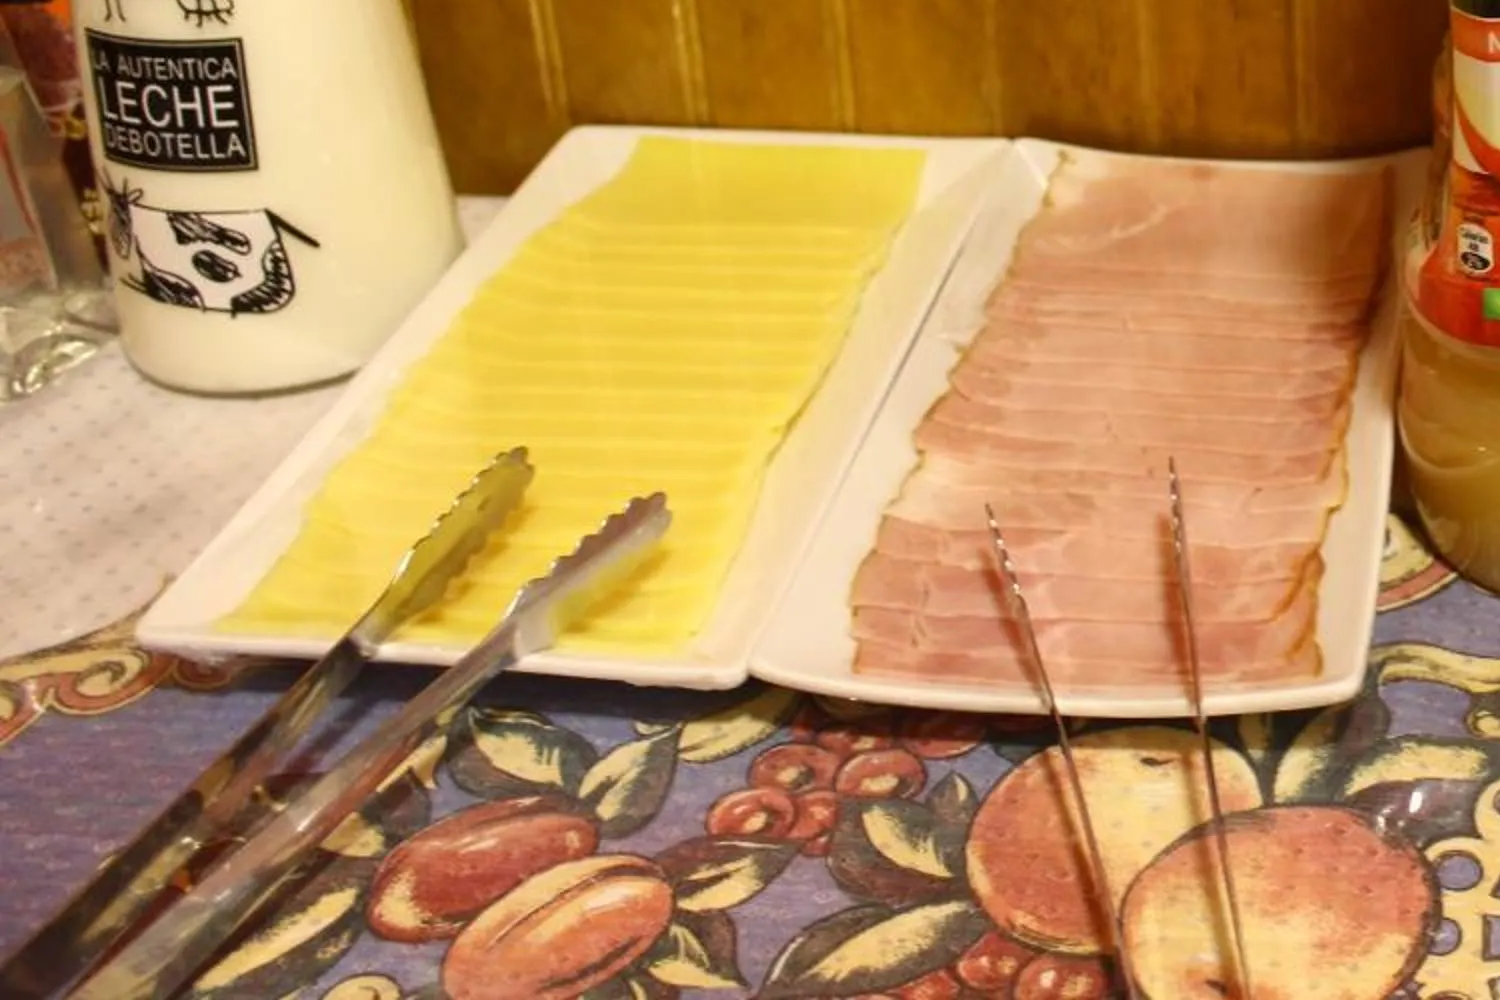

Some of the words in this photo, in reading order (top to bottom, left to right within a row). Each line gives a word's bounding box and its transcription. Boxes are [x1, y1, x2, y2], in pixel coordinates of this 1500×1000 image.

[117, 55, 237, 81] AUTENTICA
[98, 77, 239, 128] LECHE
[104, 123, 246, 160] DEBOTELLA
